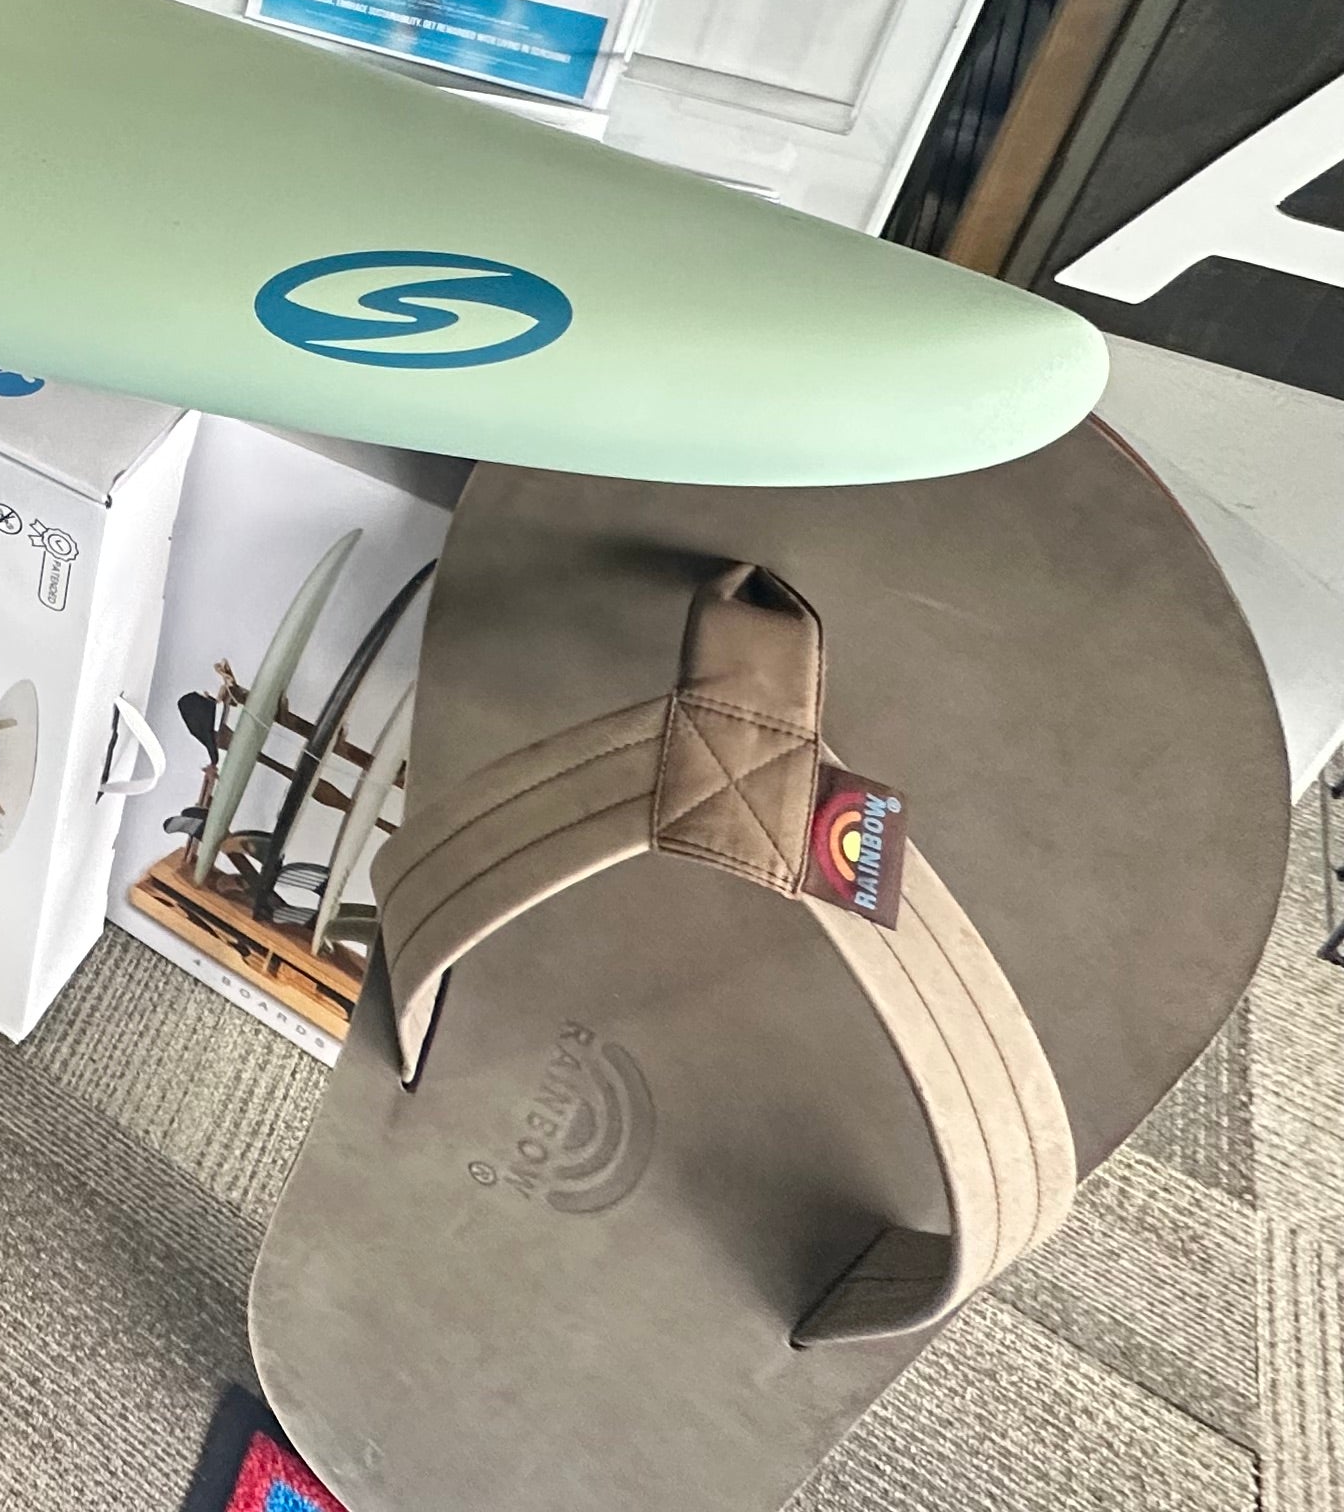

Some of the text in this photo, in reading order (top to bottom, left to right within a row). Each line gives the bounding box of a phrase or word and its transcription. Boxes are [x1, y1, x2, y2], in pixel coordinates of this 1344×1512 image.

[853, 791, 889, 912] RAINBOW
[221, 975, 325, 1049] BOARDS
[504, 1018, 597, 1201] RAINBOW
